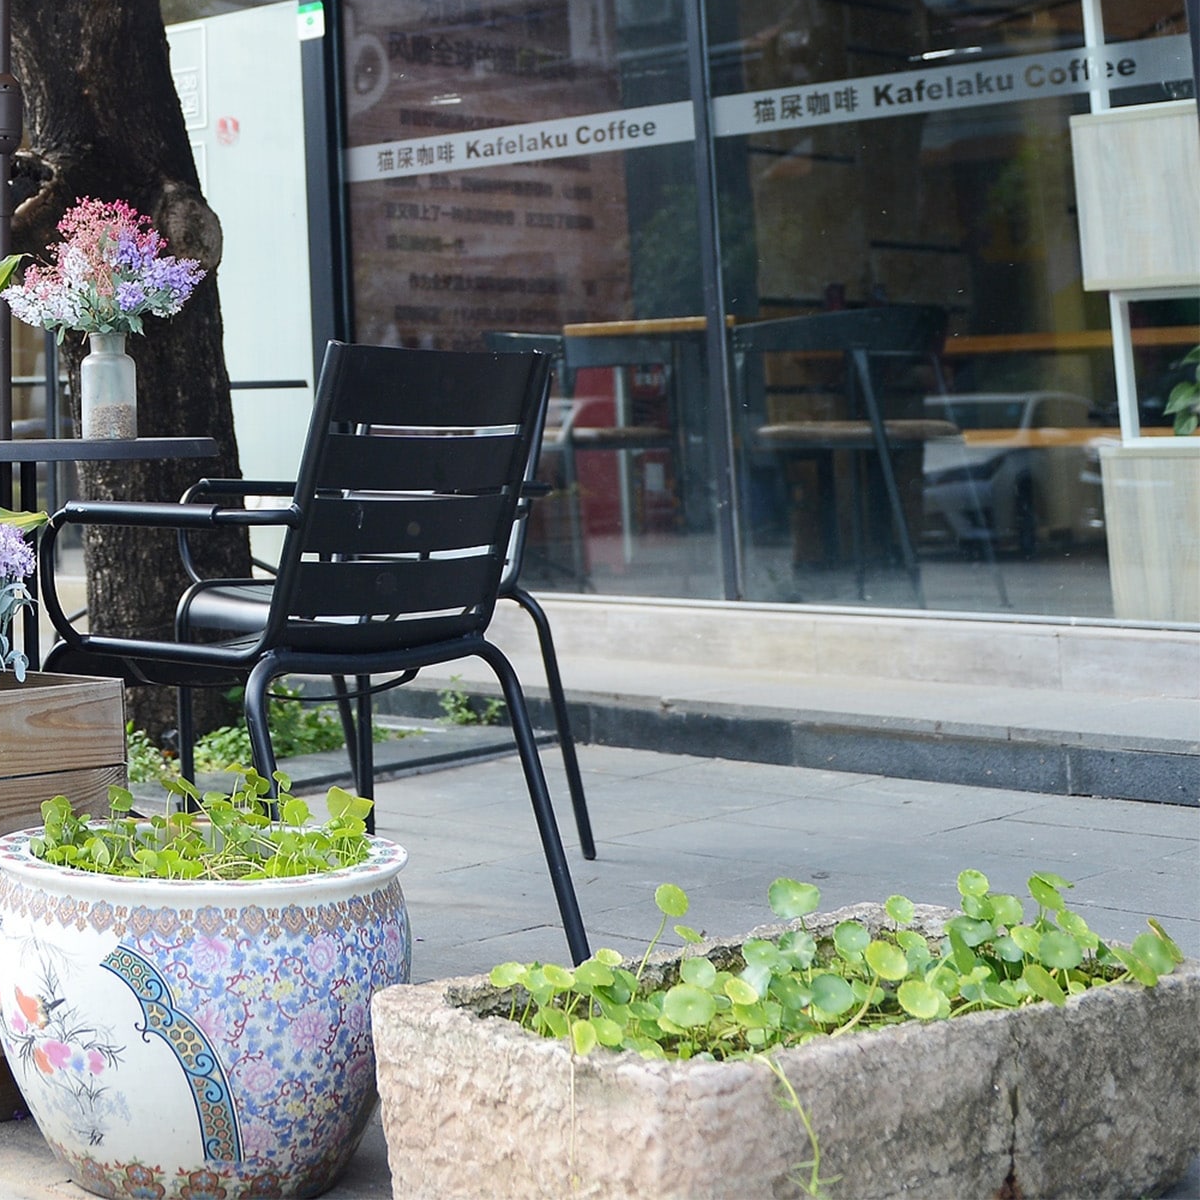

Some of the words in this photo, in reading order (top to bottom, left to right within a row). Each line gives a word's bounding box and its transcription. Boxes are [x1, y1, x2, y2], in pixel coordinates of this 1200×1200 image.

[753, 86, 859, 125] 猫屎咖啡
[873, 71, 1014, 107] Kafelaku
[377, 142, 455, 172] 猫屎咖啡
[465, 131, 568, 160] Kafelaku
[575, 120, 657, 145] Coffee
